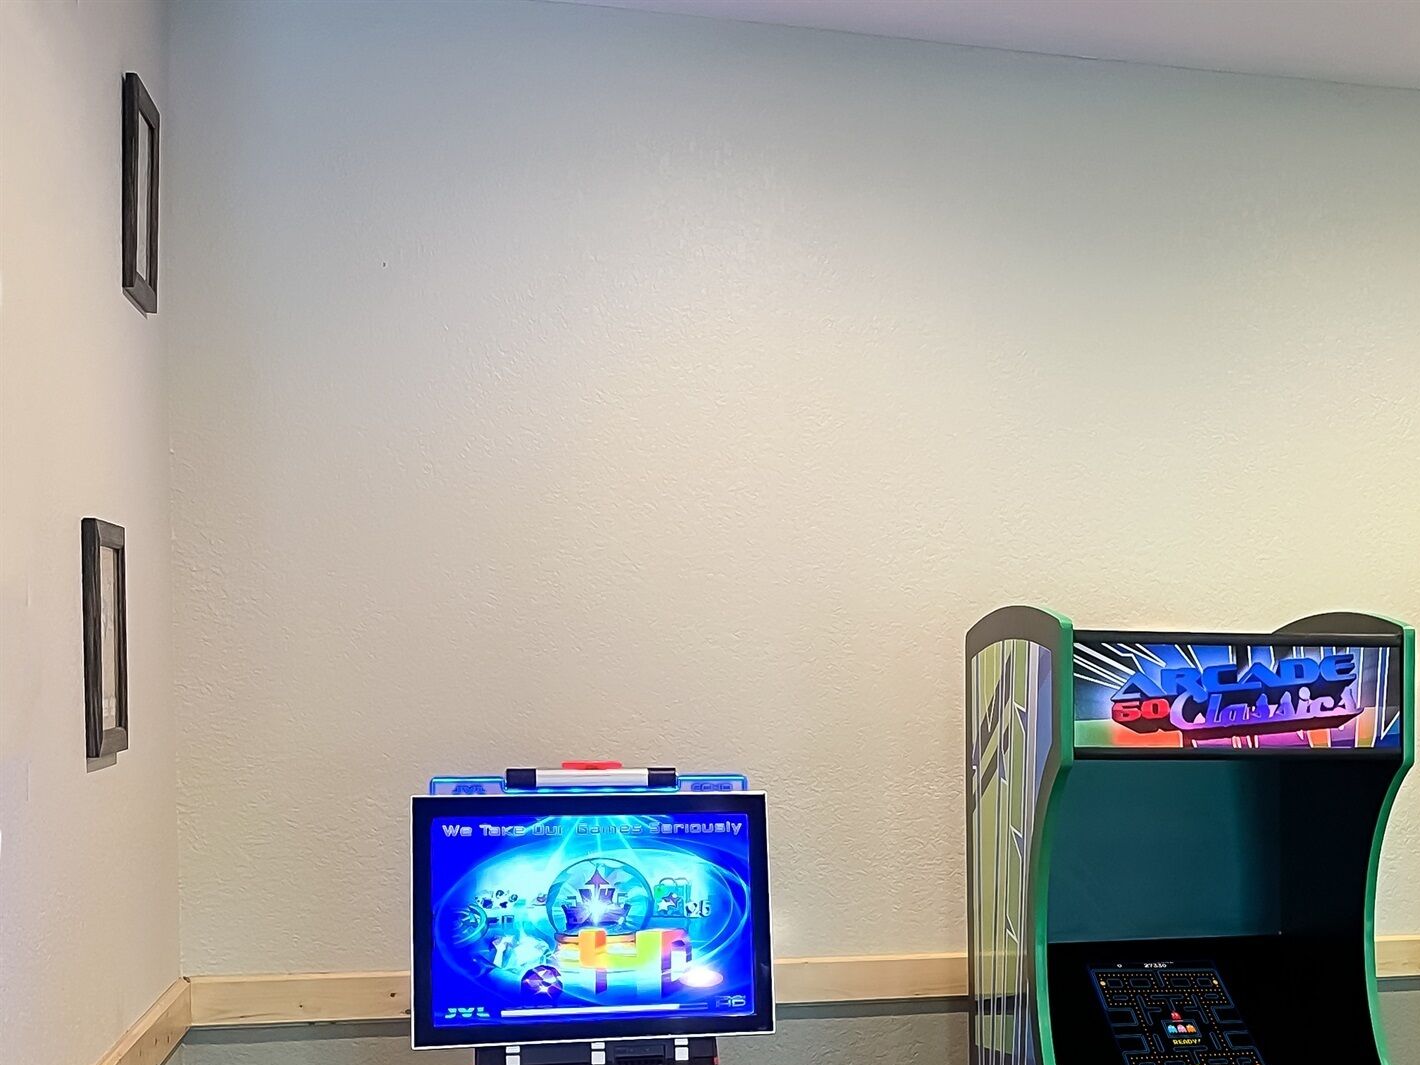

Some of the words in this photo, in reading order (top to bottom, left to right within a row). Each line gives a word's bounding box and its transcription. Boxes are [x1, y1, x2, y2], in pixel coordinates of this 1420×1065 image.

[1111, 654, 1358, 700] ARCADE
[1169, 687, 1364, 730] Classics
[442, 824, 473, 838] We
[479, 823, 526, 838] Take
[532, 824, 564, 837] Our
[576, 822, 643, 836] Games
[650, 820, 743, 837] Seriously
[444, 1006, 491, 1020] JVL
